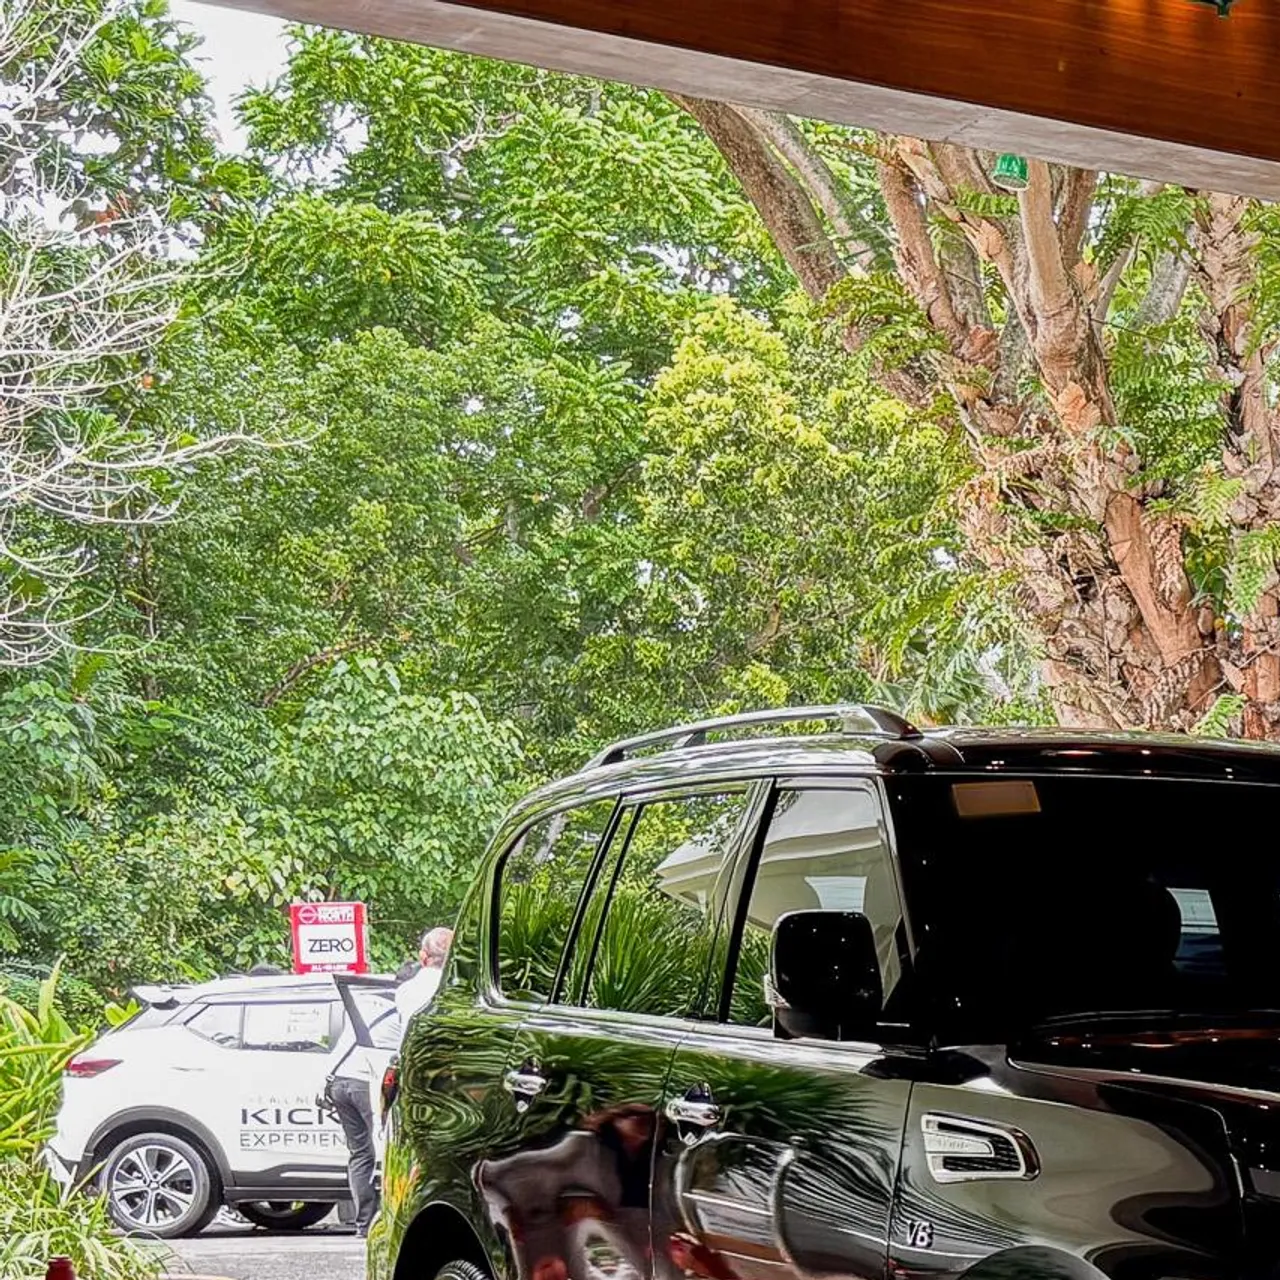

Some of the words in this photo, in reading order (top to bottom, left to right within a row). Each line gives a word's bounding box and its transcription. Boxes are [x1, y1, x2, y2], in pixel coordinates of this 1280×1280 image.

[308, 938, 354, 952] ZERO
[241, 1108, 341, 1125] KICK
[240, 1133, 347, 1147] EXPERIEN
